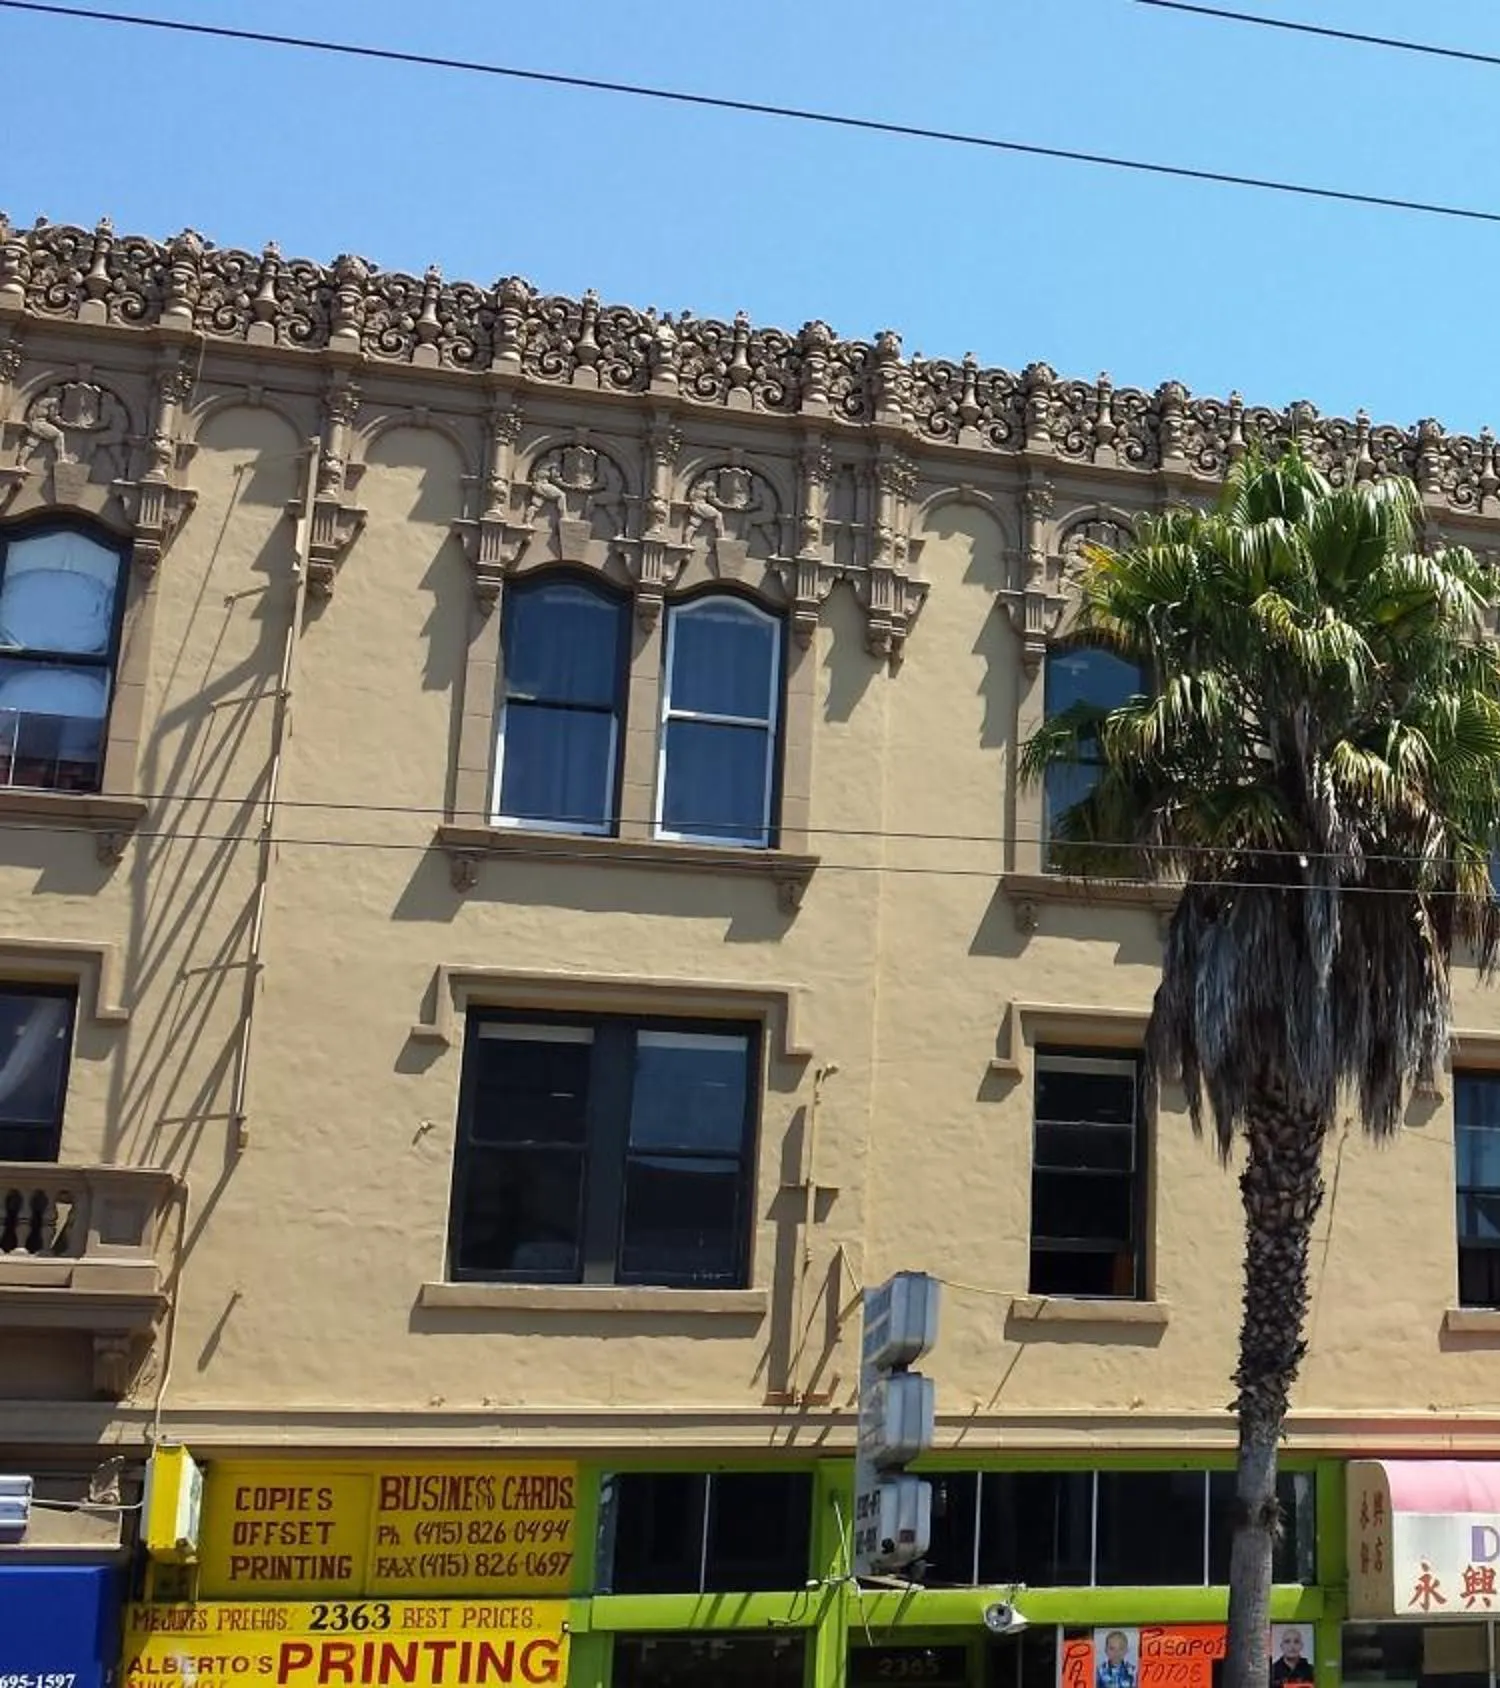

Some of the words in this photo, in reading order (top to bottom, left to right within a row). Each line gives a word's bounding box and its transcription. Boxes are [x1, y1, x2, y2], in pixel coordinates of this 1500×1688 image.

[235, 1487, 333, 1511] COPIES
[379, 1475, 495, 1511] BUSINESS
[233, 1521, 336, 1546] OFFSET
[414, 1520, 463, 1545] (415)
[467, 1520, 507, 1545] 826
[514, 1519, 571, 1544] 0494
[229, 1555, 353, 1581] PRINTING
[376, 1557, 416, 1578] FAX
[418, 1553, 469, 1578] (415)
[308, 1603, 391, 1631] 2363
[402, 1607, 452, 1629] BEST
[277, 1638, 561, 1685] PRINTING
